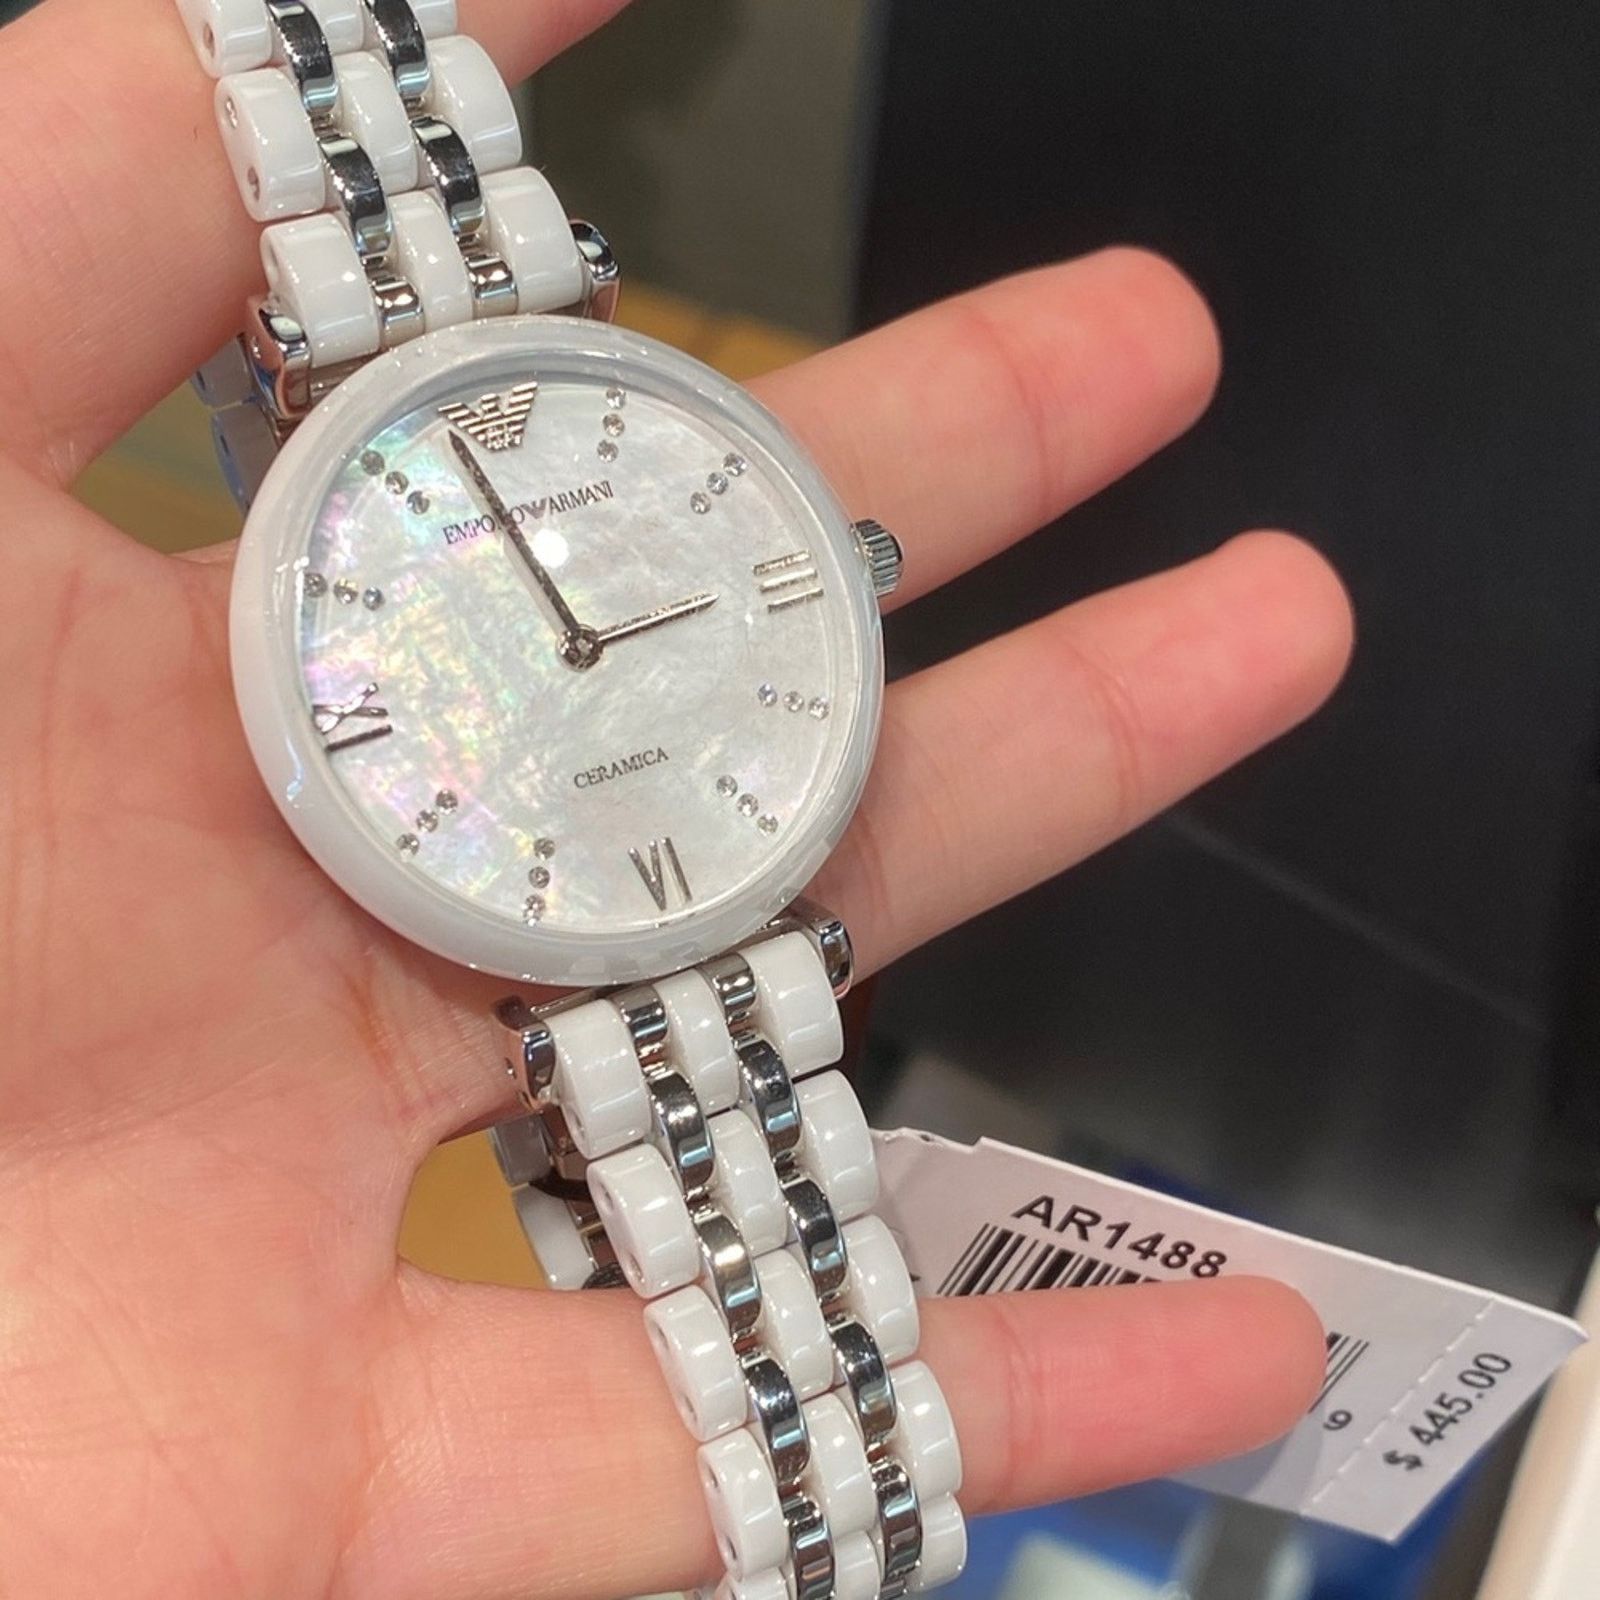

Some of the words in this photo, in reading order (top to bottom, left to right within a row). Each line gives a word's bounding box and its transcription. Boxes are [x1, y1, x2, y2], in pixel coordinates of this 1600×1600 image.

[443, 503, 525, 545] EMPOO
[549, 480, 614, 515] ARMANI
[753, 550, 824, 614] III
[573, 747, 669, 788] CERAMICA
[627, 837, 692, 911] VI
[1010, 1194, 1228, 1279] AR1488
[1409, 1352, 1512, 1446] 445.00
